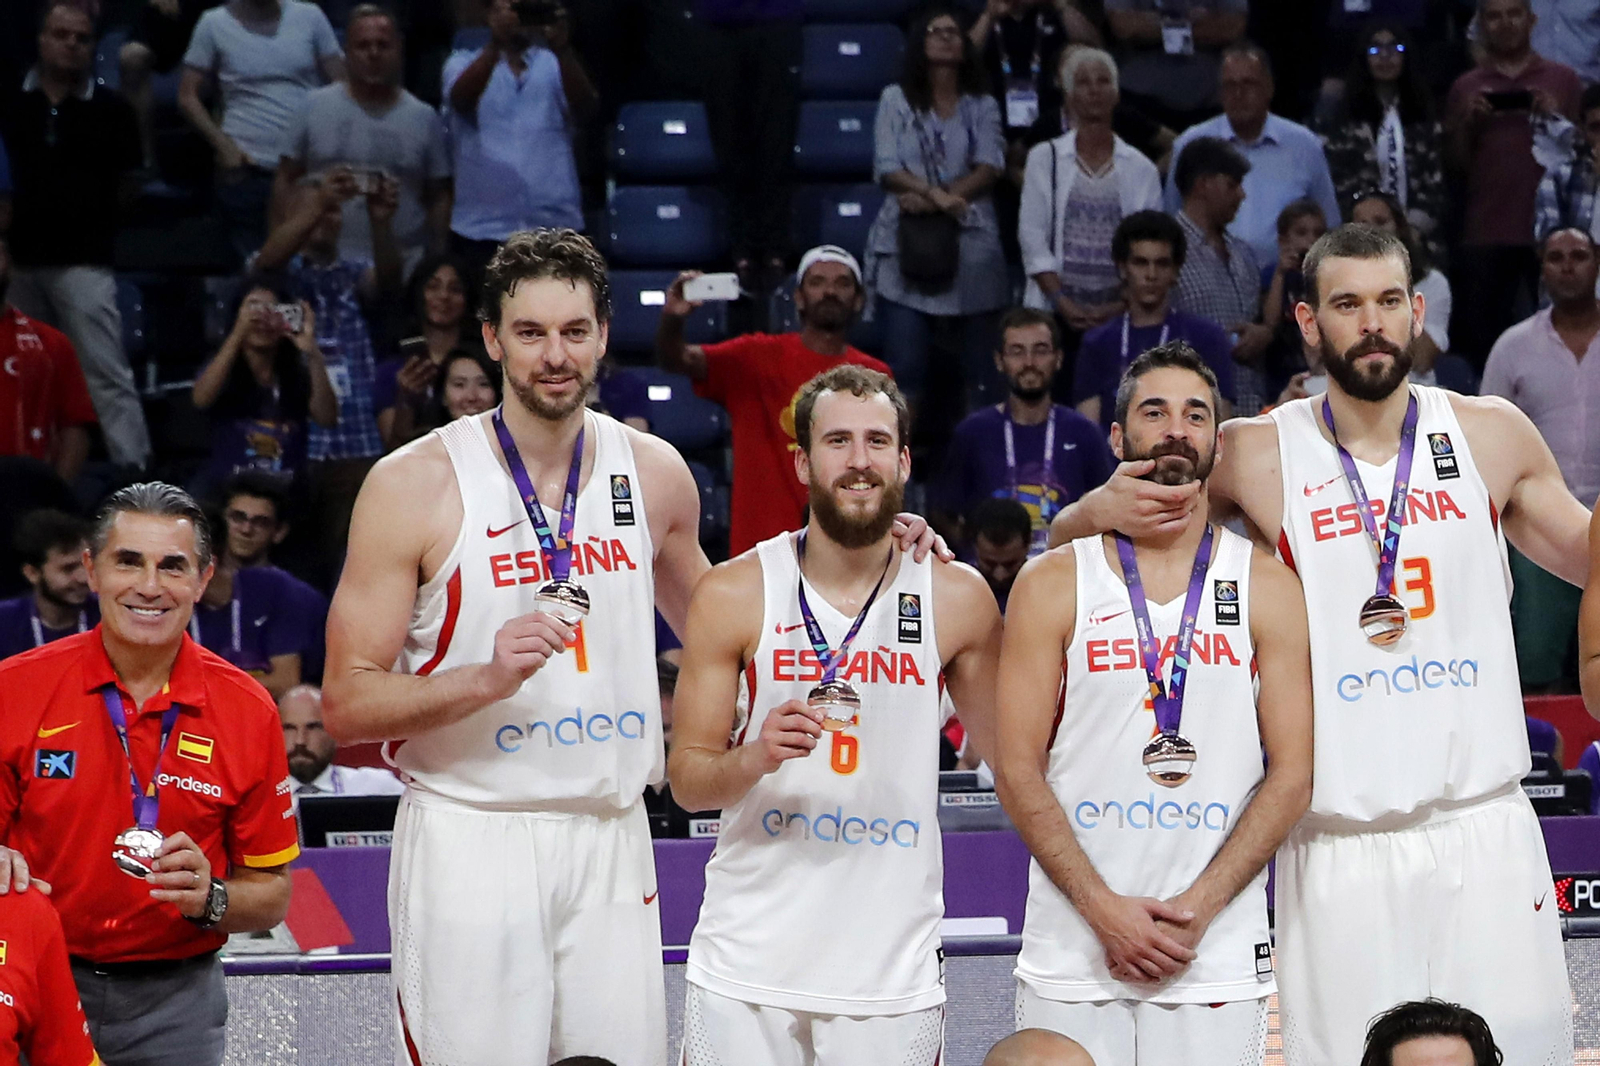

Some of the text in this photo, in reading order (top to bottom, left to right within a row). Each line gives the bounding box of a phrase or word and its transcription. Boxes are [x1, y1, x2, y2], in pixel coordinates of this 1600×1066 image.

[1437, 458, 1455, 469] FIBA
[1310, 488, 1467, 542] ESPÑA
[1377, 556, 1436, 621] 3
[901, 621, 919, 632] FIBA
[1218, 604, 1237, 615] FIBA
[1337, 655, 1478, 702] endesa
[495, 706, 645, 753] endea
[157, 773, 222, 798] endesa
[762, 806, 920, 848] endesa
[1075, 792, 1230, 831] endesa
